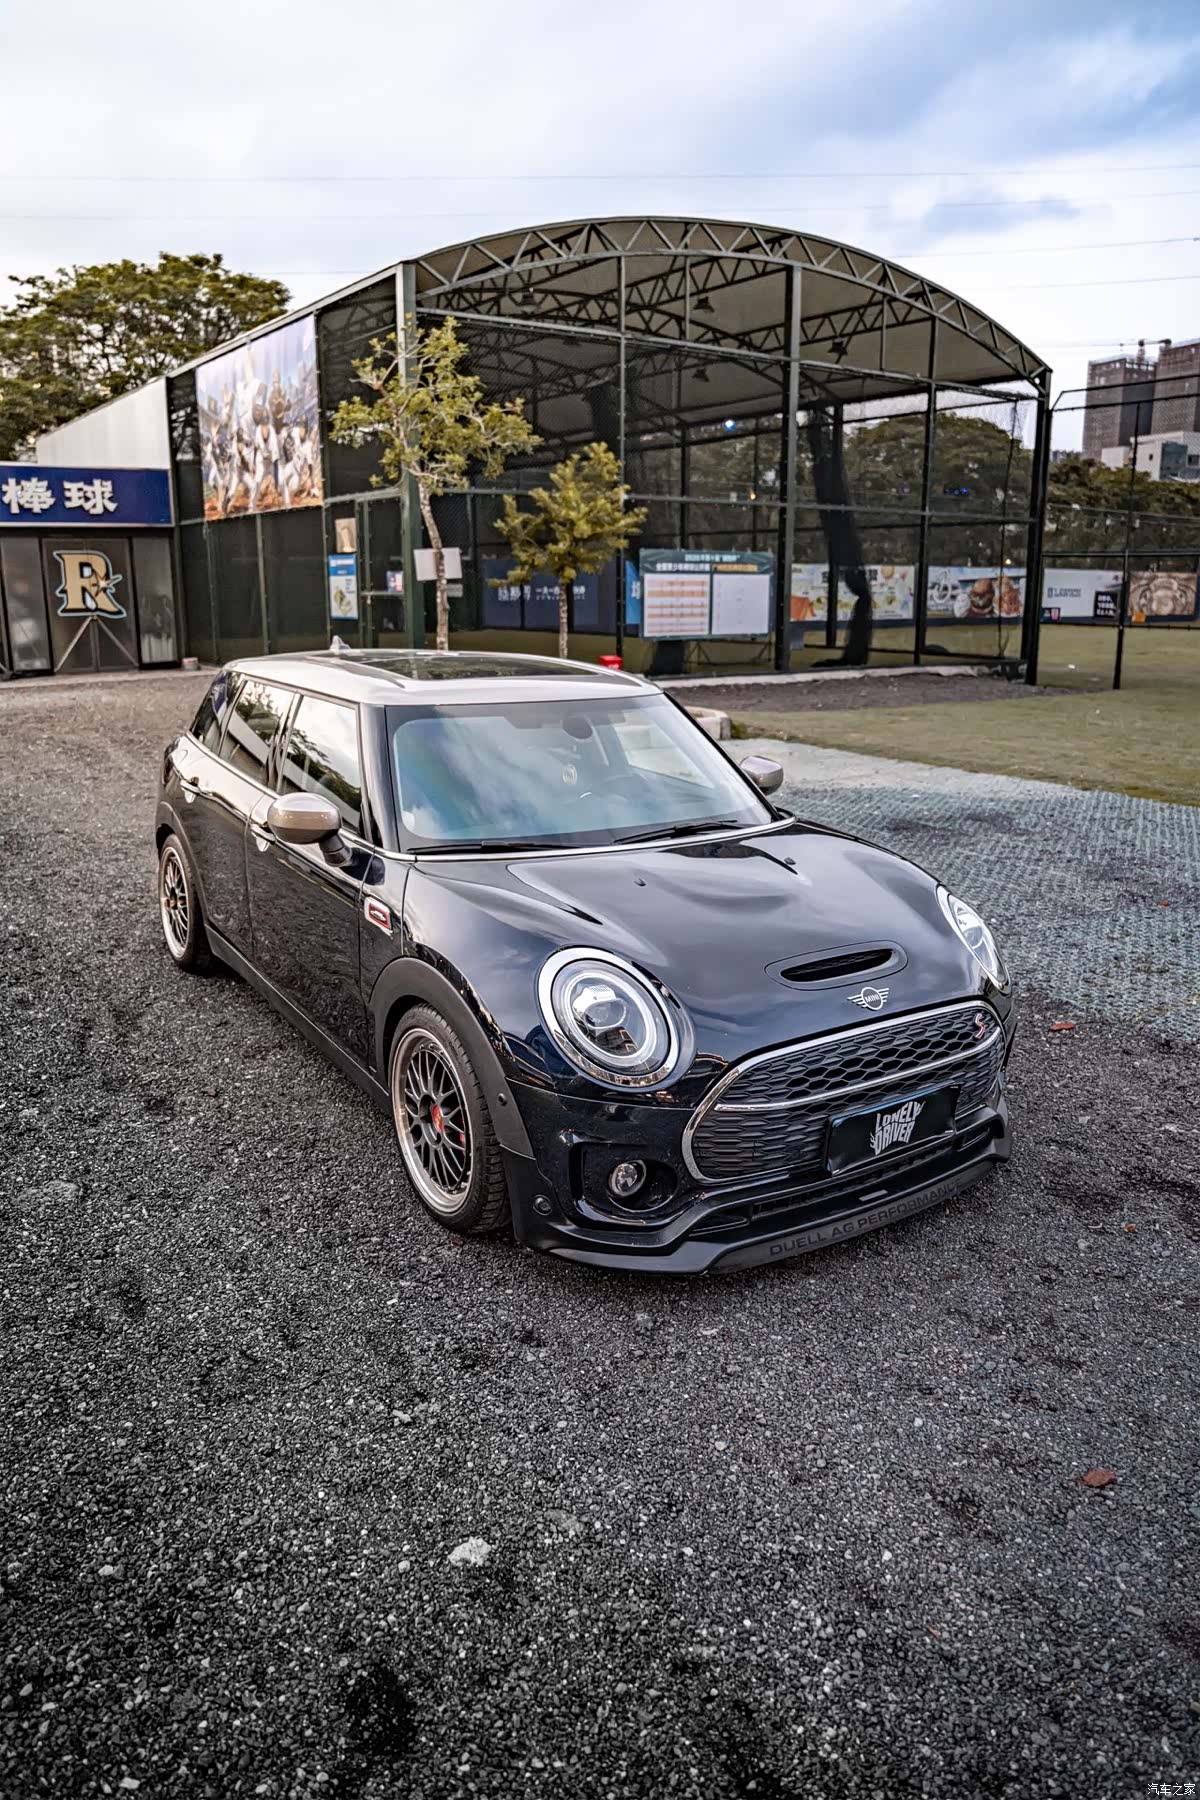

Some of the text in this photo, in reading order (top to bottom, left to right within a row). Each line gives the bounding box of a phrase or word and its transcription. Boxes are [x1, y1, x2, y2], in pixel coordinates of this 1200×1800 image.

[2, 477, 118, 515] 棒球
[53, 550, 127, 618] R
[864, 994, 880, 1003] MINI
[875, 1101, 926, 1133] LONELY
[870, 1120, 916, 1156] DRIVER
[769, 1178, 962, 1256] DUELL AG PERFORMANCE
